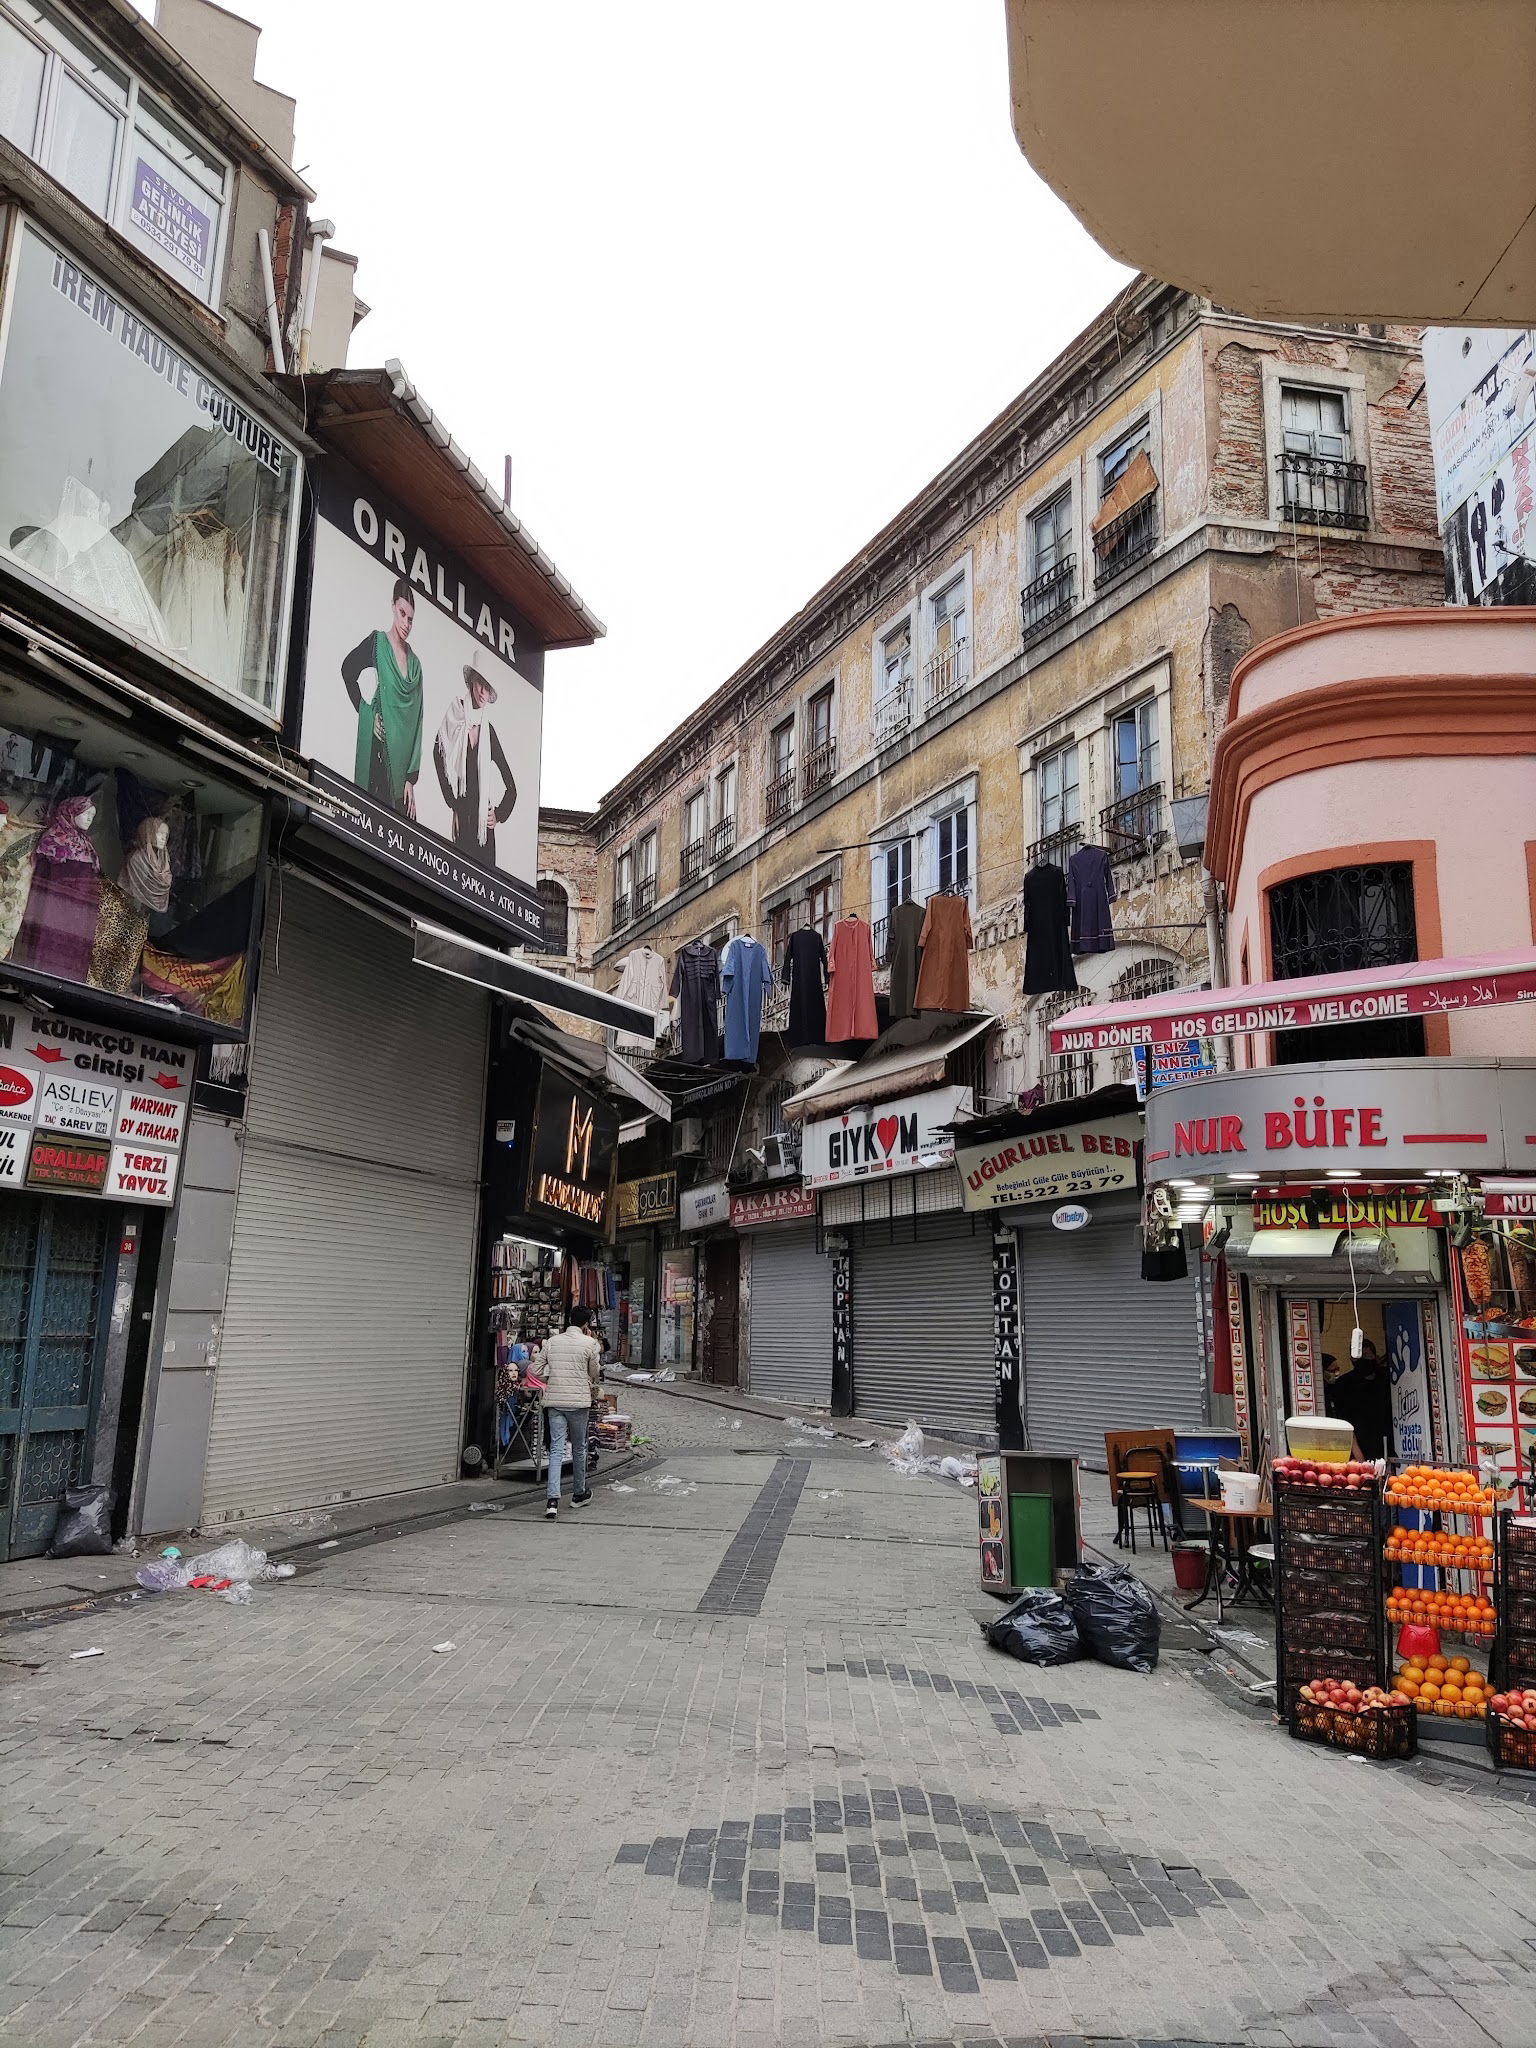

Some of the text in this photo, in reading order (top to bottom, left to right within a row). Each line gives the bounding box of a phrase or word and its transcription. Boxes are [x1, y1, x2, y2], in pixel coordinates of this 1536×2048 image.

[141, 180, 202, 242] GELİNLİK
[155, 177, 193, 215] SEVDA
[138, 198, 202, 261] ATÖLYESİ
[163, 239, 179, 255] 291
[181, 255, 192, 266] 79
[52, 254, 283, 474] İREM HAUTE COUTURE
[353, 497, 516, 664] ORALLAR
[387, 829, 405, 852] ŞAL
[418, 845, 450, 877] PANÇO
[461, 872, 487, 899] ŞAPKA
[497, 895, 515, 915] ATKI
[524, 908, 541, 929] BERE
[1062, 993, 1408, 1050] NUR DÖNER HOŞ GELDİNİZ WELCOME
[31, 1015, 186, 1069] KÜRKÇÜ HAN
[73, 1053, 145, 1083] GİRİŞİ
[60, 1117, 93, 1131] SAREV
[130, 1095, 178, 1119] WARYANT
[120, 1118, 179, 1143] BY ATAKLAR
[1174, 1095, 1389, 1159] NUR BÜFE
[32, 1146, 107, 1173] ORALLAR
[124, 1152, 168, 1174] TERZİ
[966, 1133, 1075, 1192] UĞURLUEL
[1032, 1175, 1050, 1186] Güle
[1051, 1172, 1069, 1183] Güle
[1071, 1166, 1105, 1180] Büyütün
[117, 1173, 169, 1196] YAVUZ
[639, 1177, 669, 1216] gold
[733, 1187, 814, 1214] AKARSU
[1066, 1180, 1093, 1193] 23
[1098, 1174, 1125, 1188] 79
[999, 1253, 1013, 1380] TOPTAN
